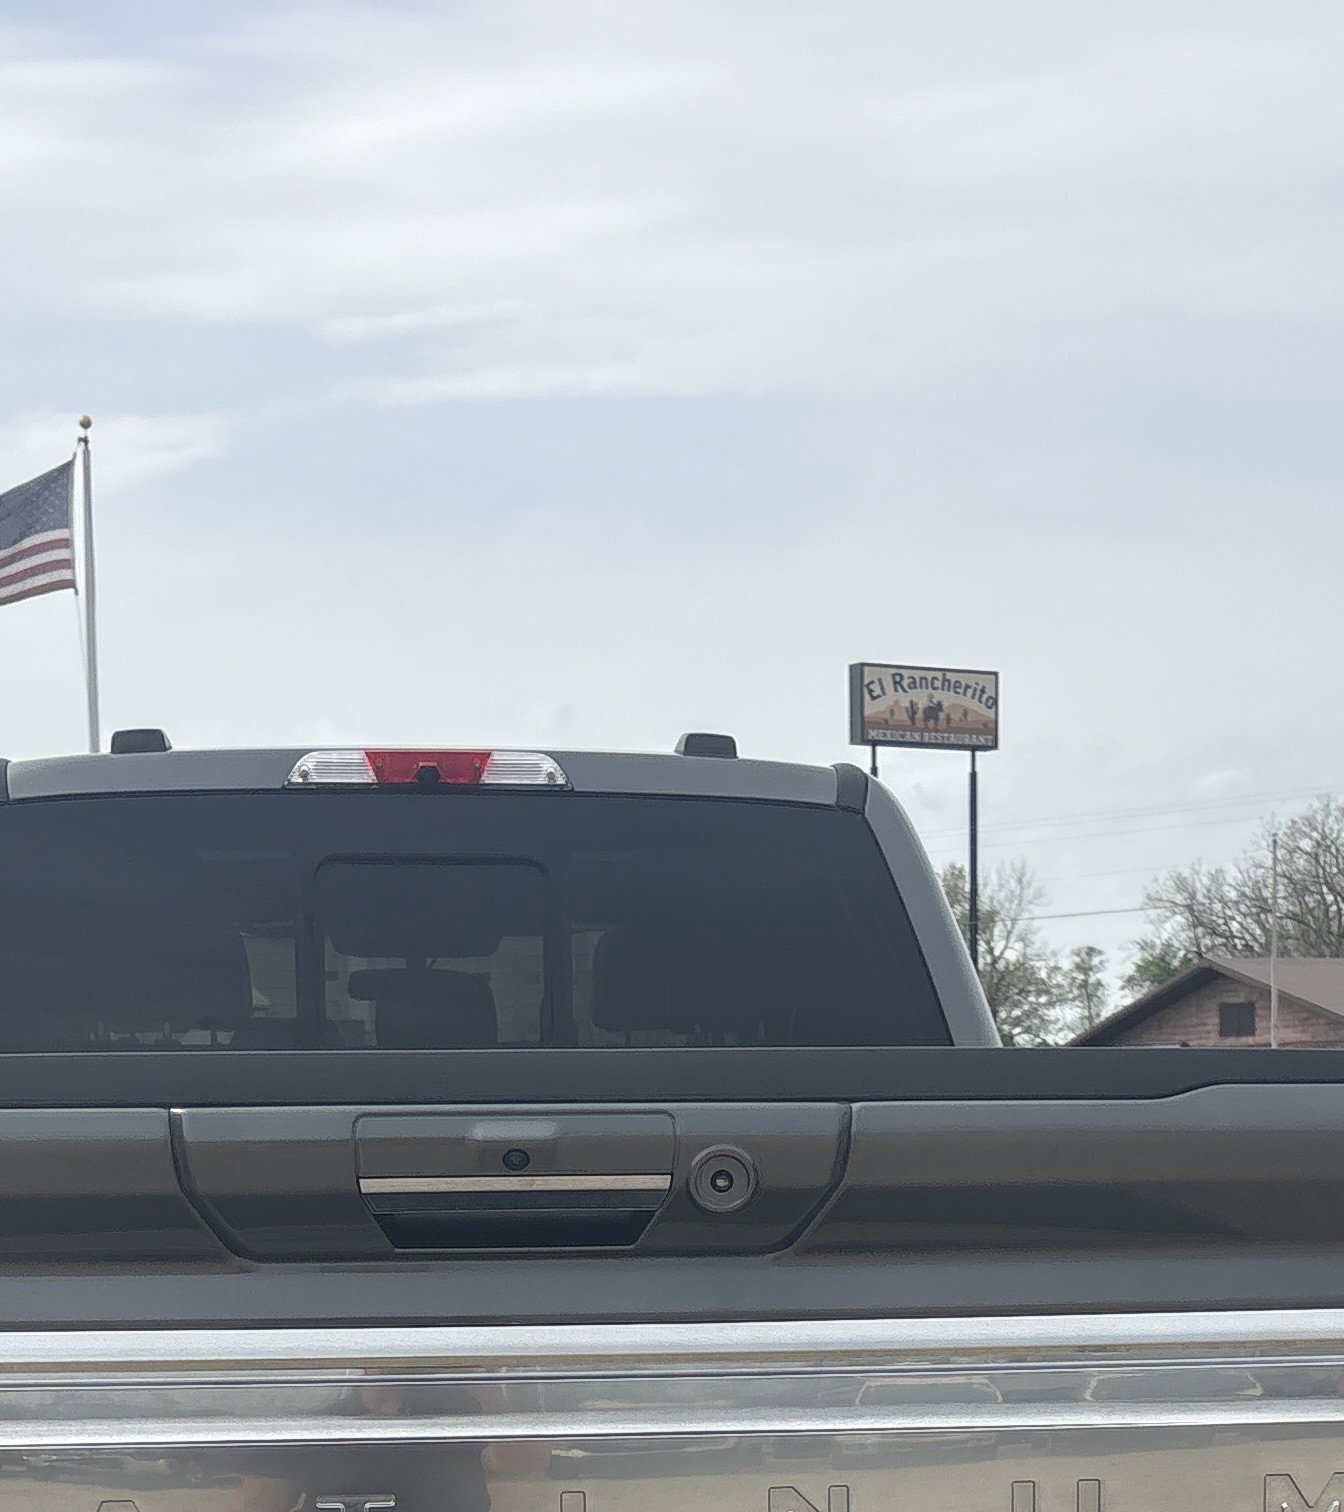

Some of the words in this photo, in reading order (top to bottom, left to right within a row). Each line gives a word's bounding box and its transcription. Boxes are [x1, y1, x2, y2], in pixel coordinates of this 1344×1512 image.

[864, 677, 886, 701] El
[891, 672, 997, 710] Rancherito
[868, 729, 922, 742] MEXICAN
[923, 732, 995, 746] RESTAURANT
